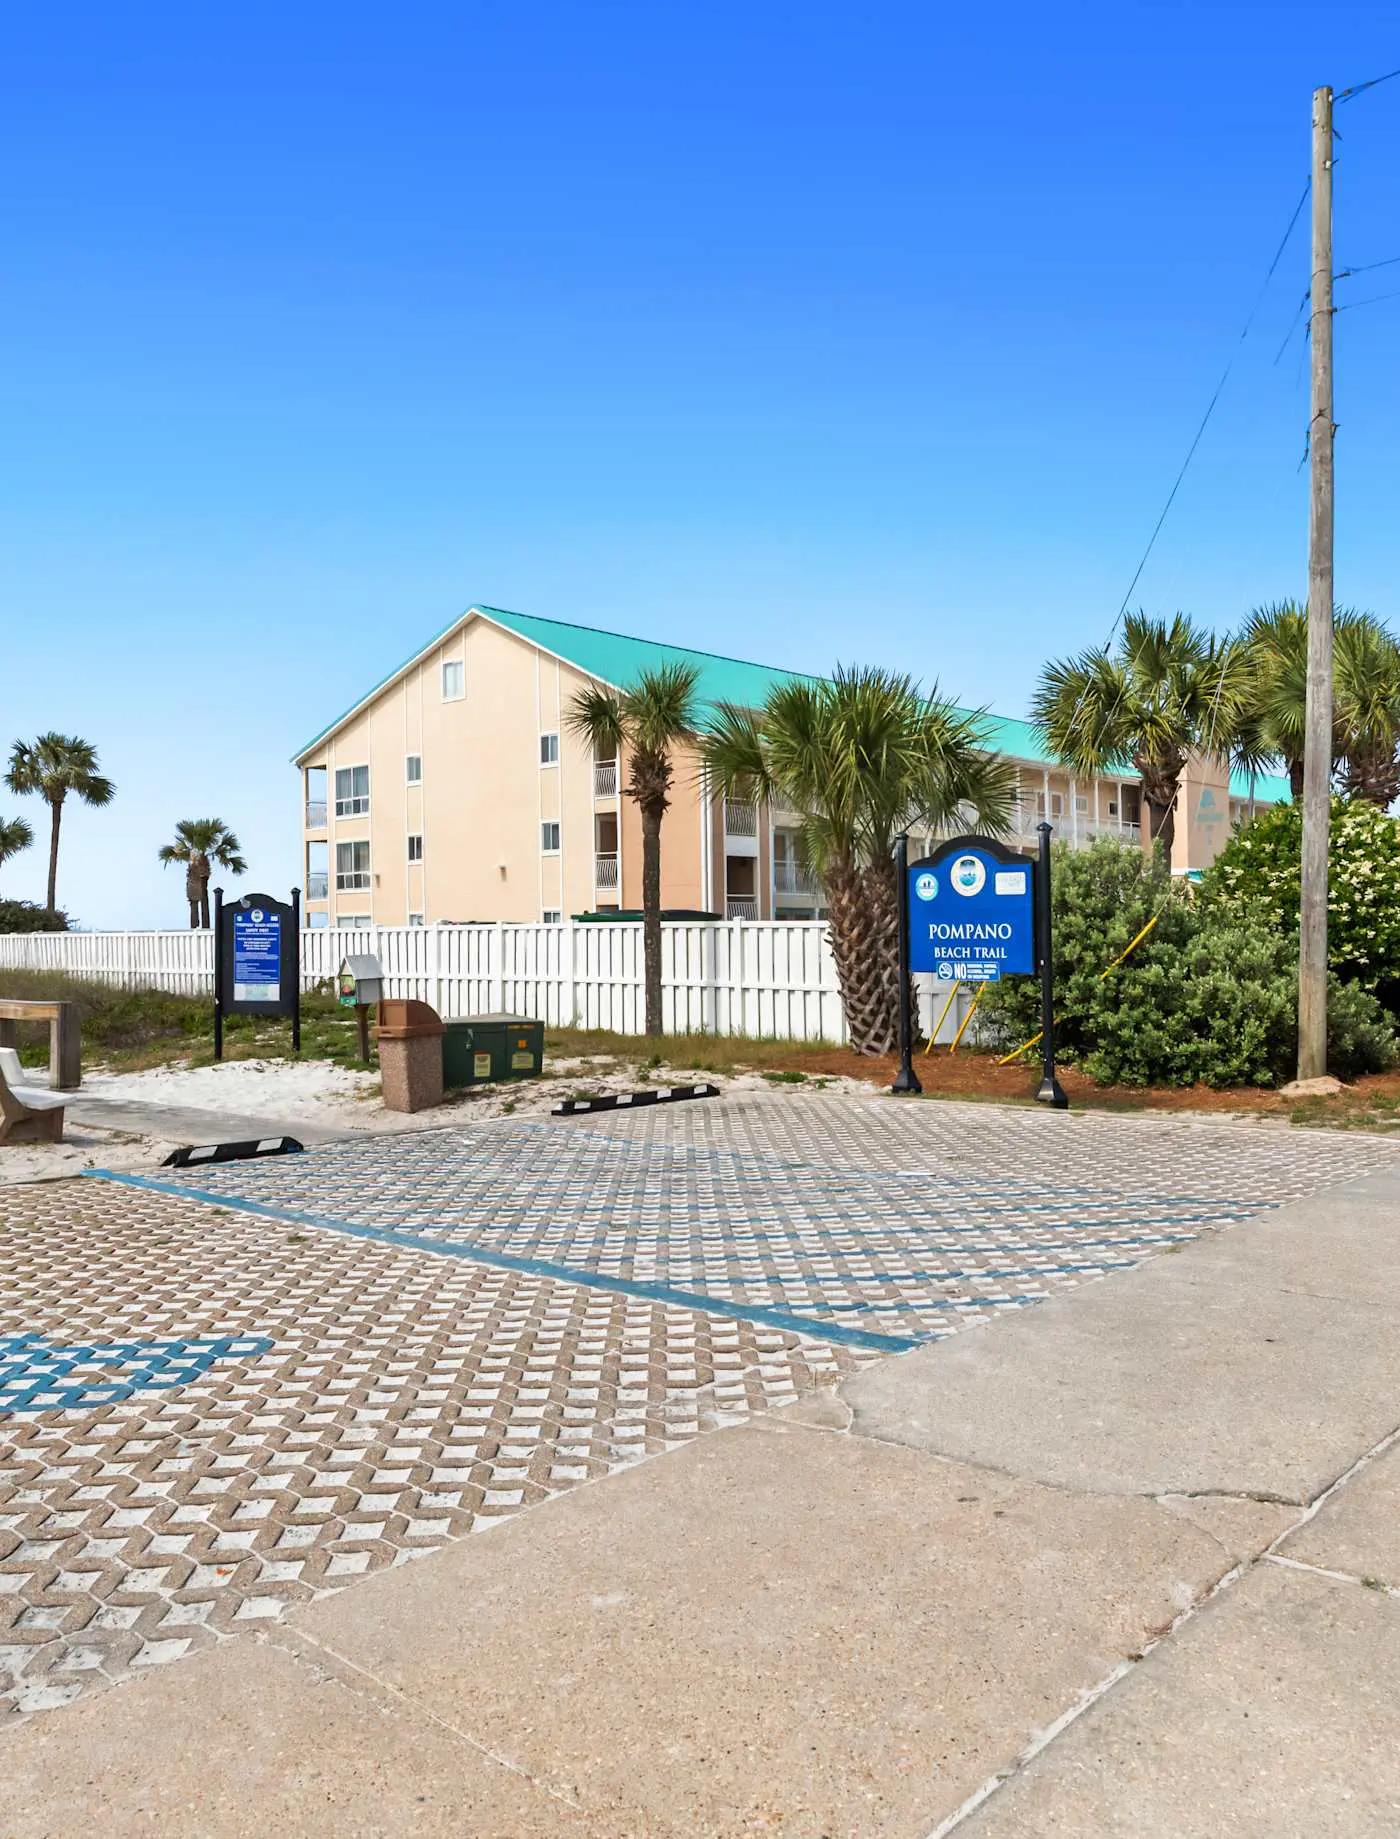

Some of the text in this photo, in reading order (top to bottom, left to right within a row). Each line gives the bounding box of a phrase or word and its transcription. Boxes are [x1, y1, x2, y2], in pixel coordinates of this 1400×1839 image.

[929, 923, 1012, 940] POMPANO
[934, 946, 1007, 959] BEACH TRAIL
[954, 963, 967, 979] NO
